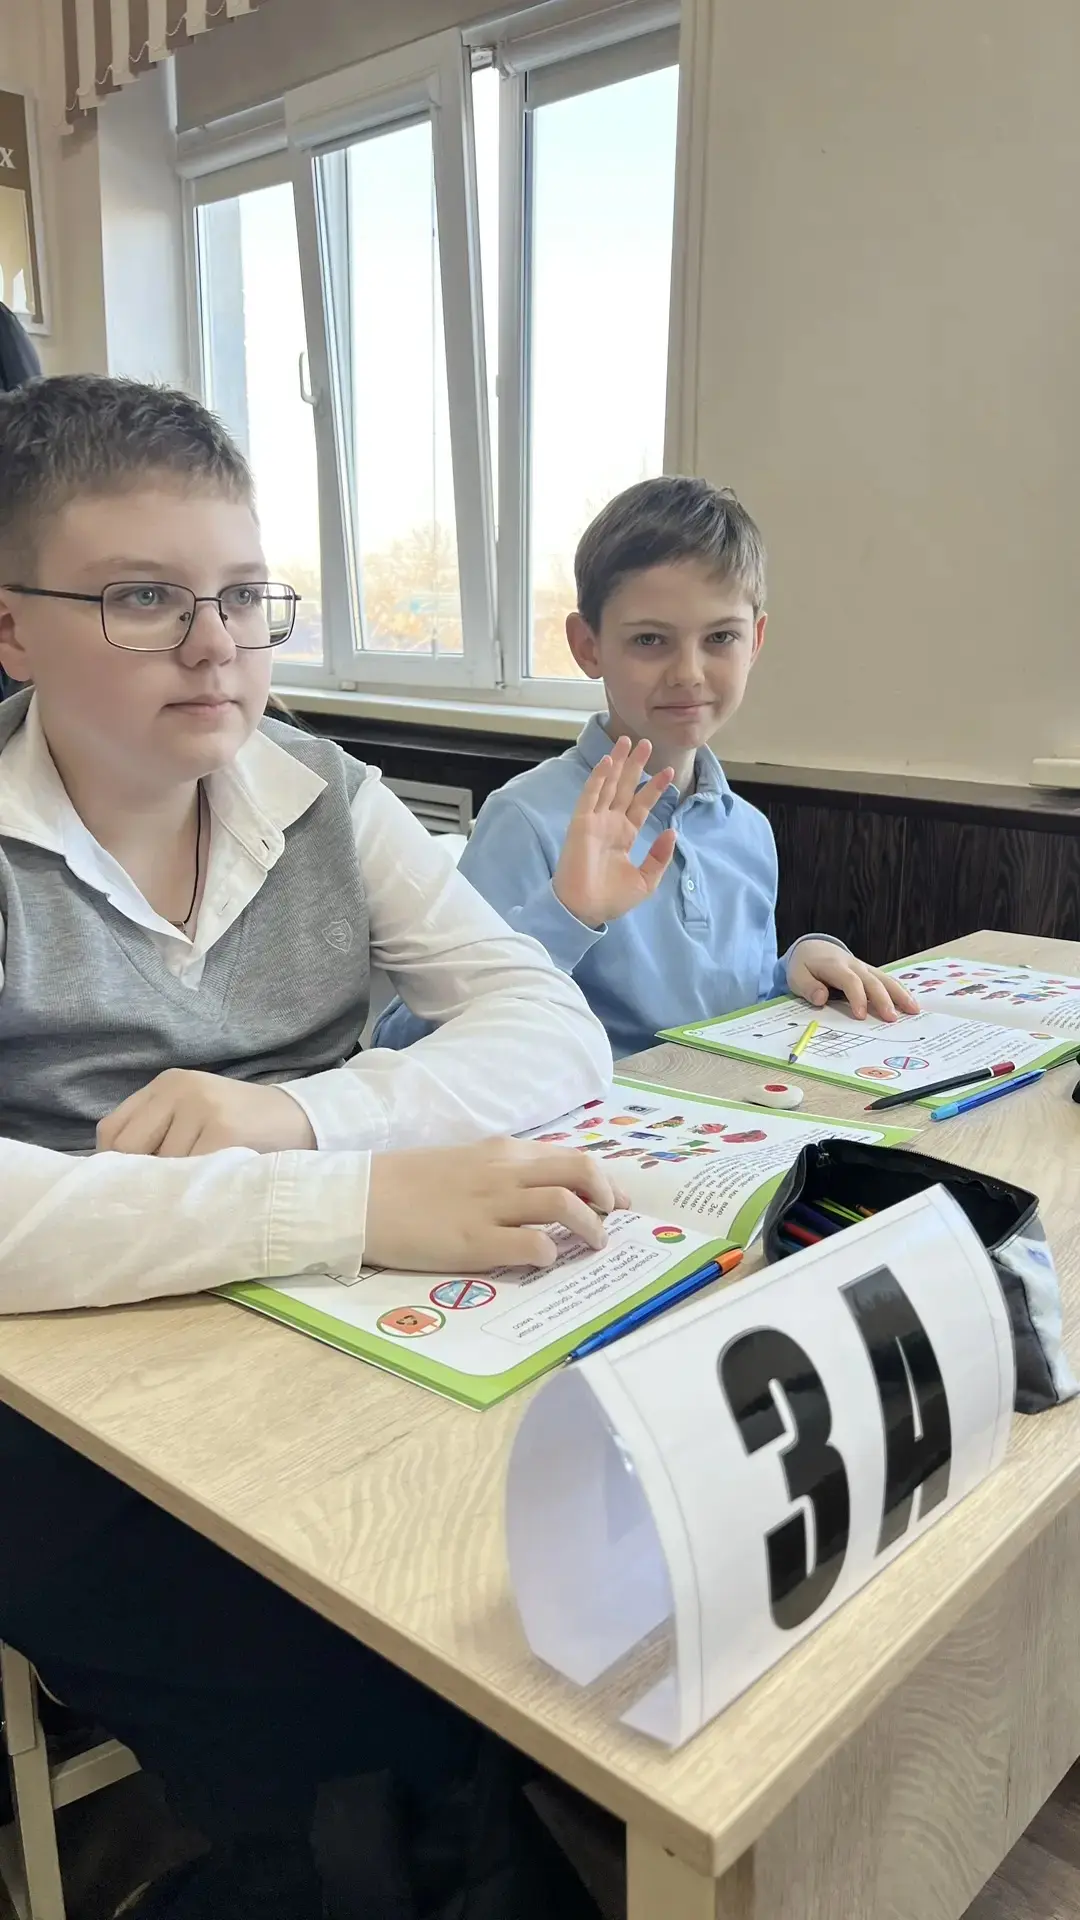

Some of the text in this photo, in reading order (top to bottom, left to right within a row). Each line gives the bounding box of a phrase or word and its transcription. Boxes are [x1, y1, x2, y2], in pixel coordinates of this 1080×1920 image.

[690, 1191, 704, 1210] отме-
[697, 1191, 715, 1214] можно
[707, 1203, 718, 1216] Зе-
[629, 1253, 658, 1272] Полезно
